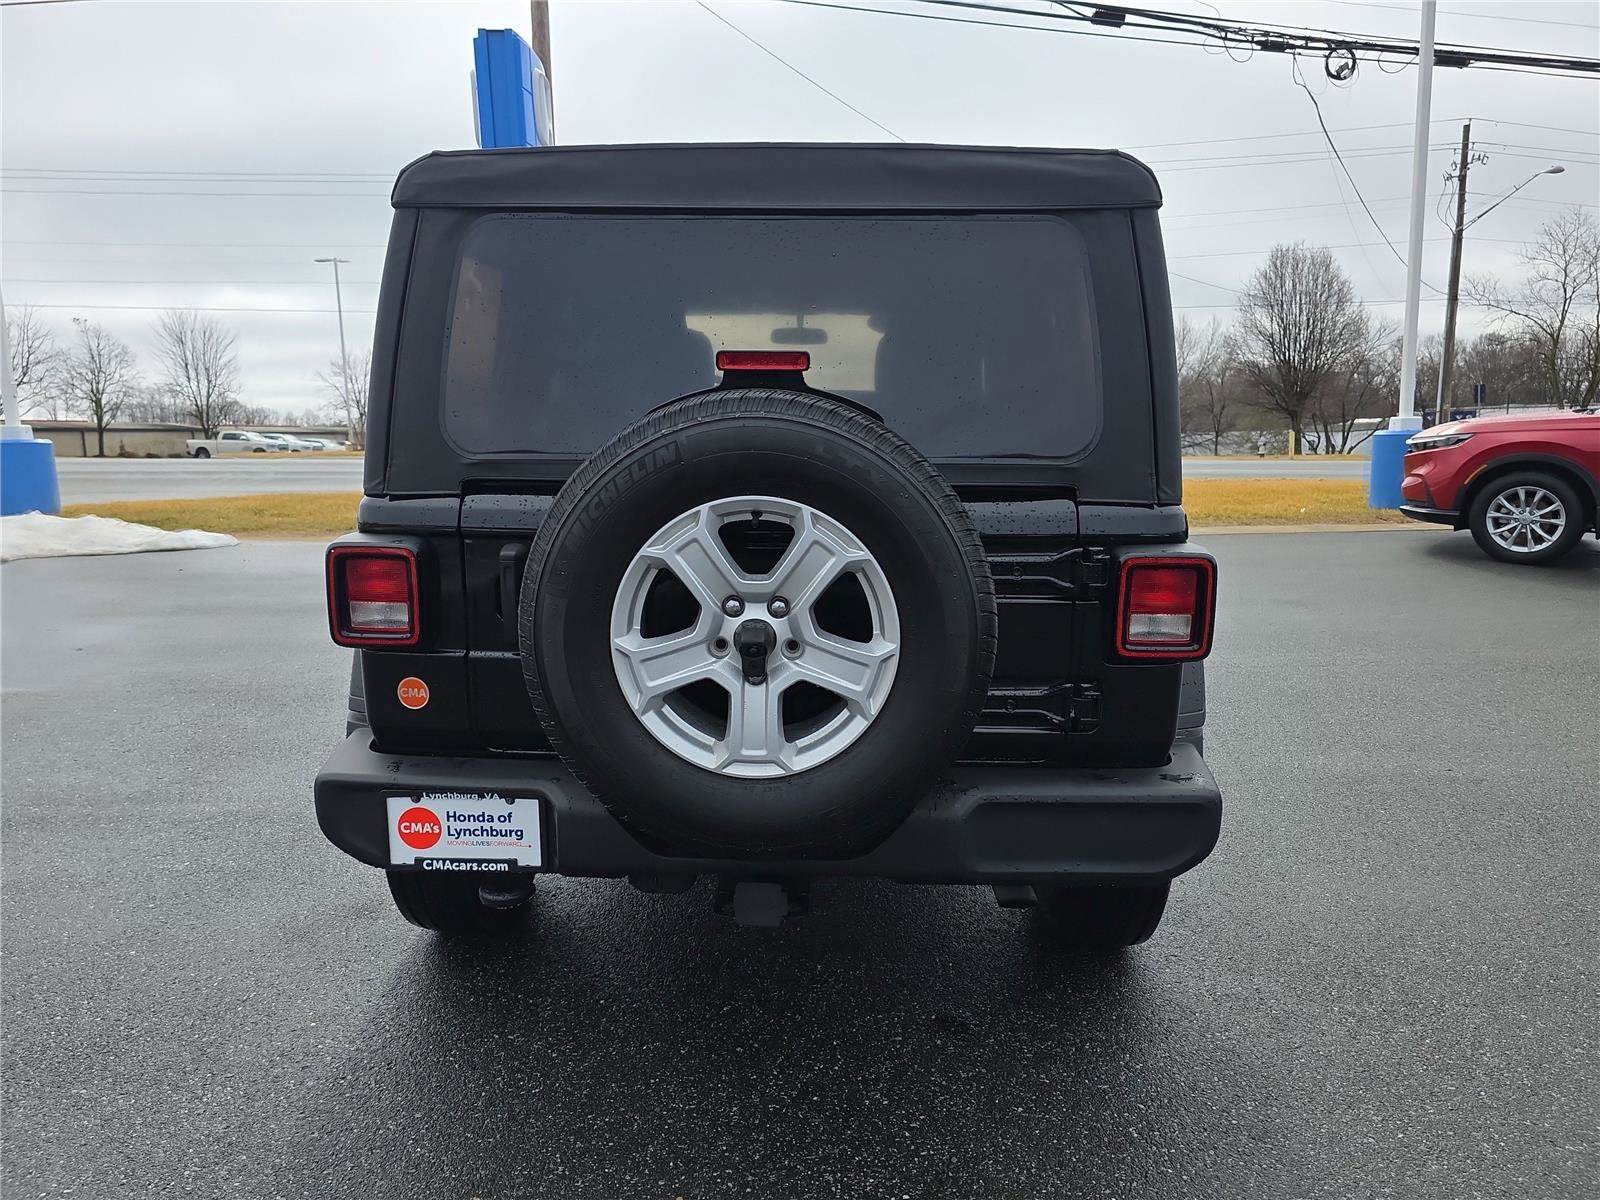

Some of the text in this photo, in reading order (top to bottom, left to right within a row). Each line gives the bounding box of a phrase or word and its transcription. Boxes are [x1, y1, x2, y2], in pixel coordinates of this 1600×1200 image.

[563, 440, 681, 560] MICHELIN
[400, 688, 427, 698] CMA
[484, 792, 500, 801] VA
[446, 811, 513, 824] Honda of
[400, 822, 440, 834] CMA's
[447, 826, 524, 841] Lynchburg
[422, 860, 509, 872] CMAcars.com
